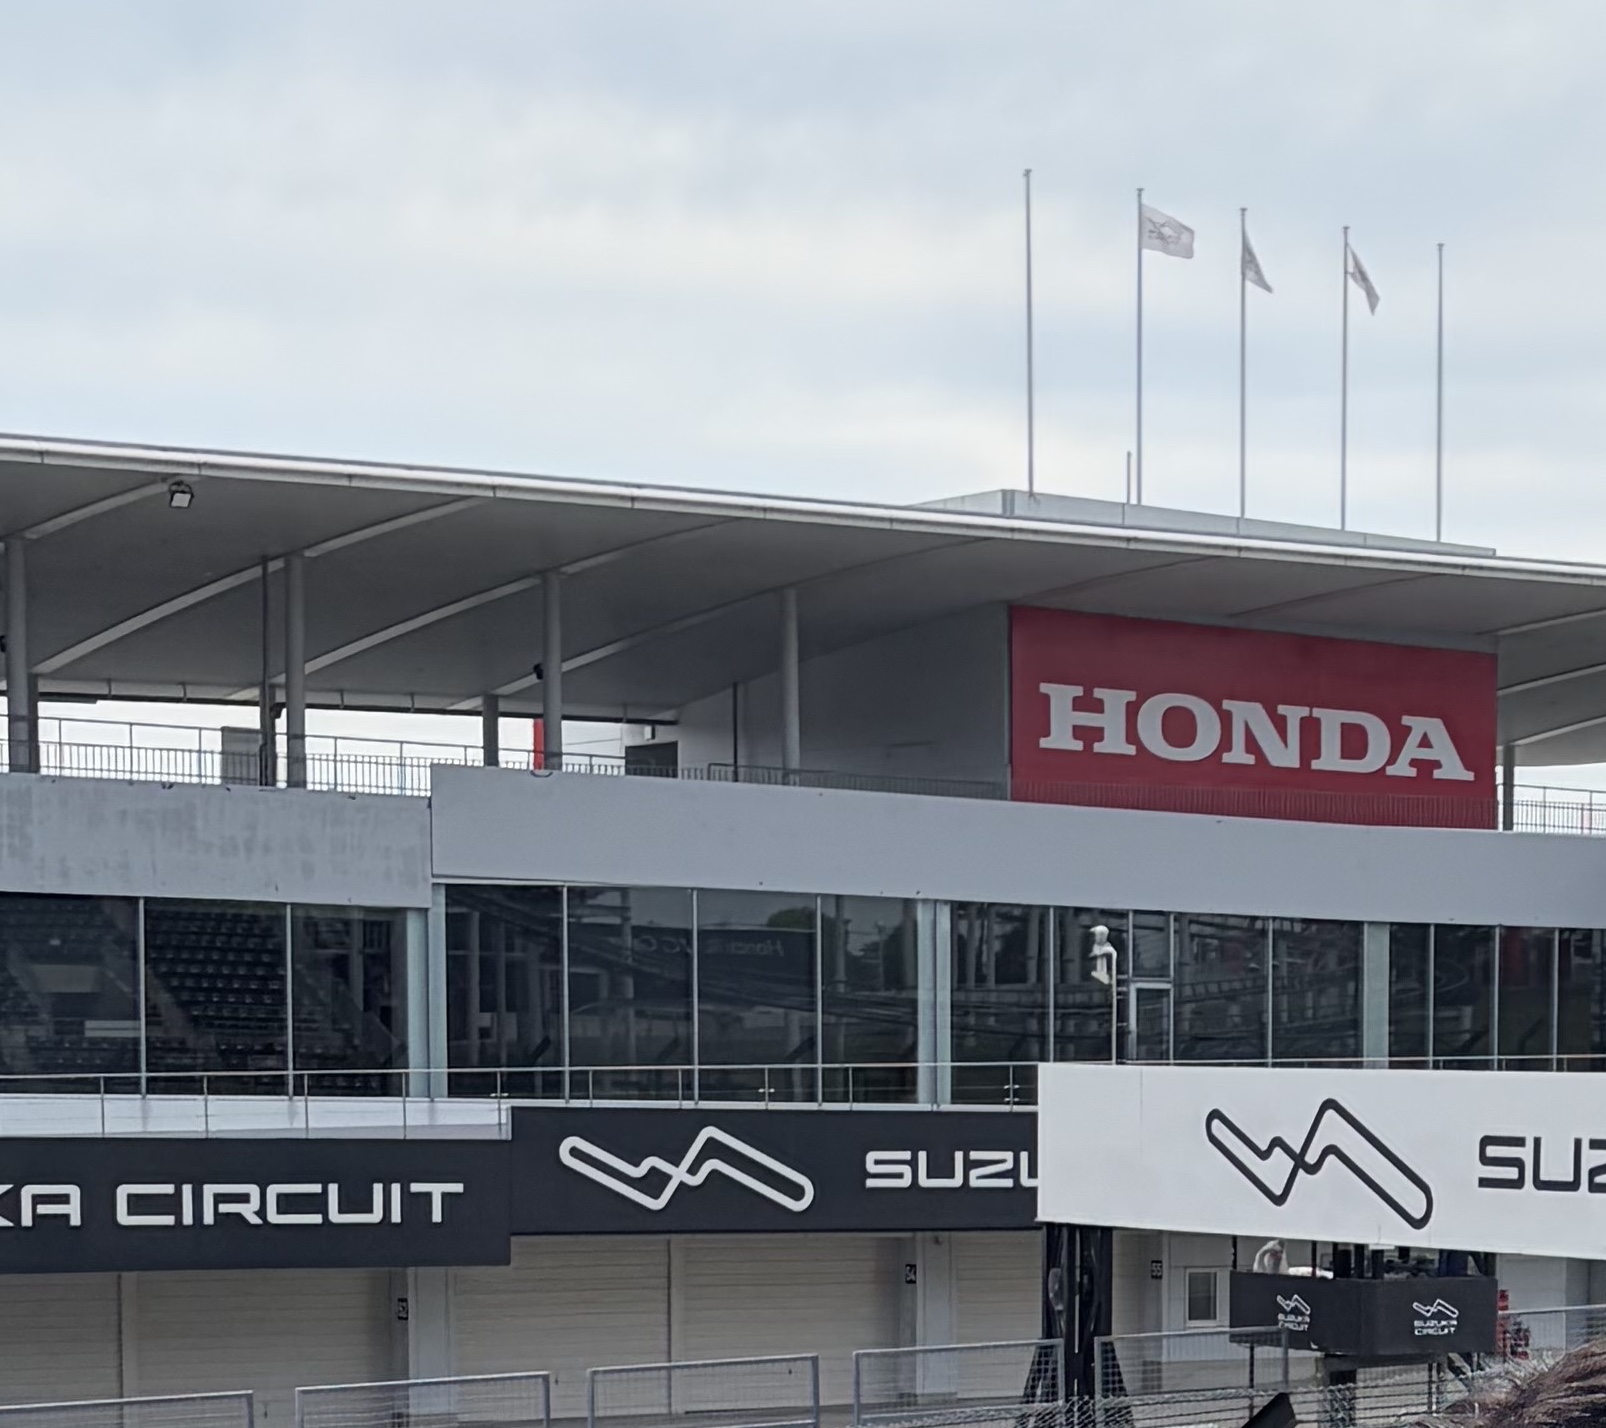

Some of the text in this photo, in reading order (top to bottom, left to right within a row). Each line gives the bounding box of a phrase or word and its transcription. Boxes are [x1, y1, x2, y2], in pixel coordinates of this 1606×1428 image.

[1038, 682, 1475, 781] HONDA
[0, 1183, 464, 1227] A CIRCUIT
